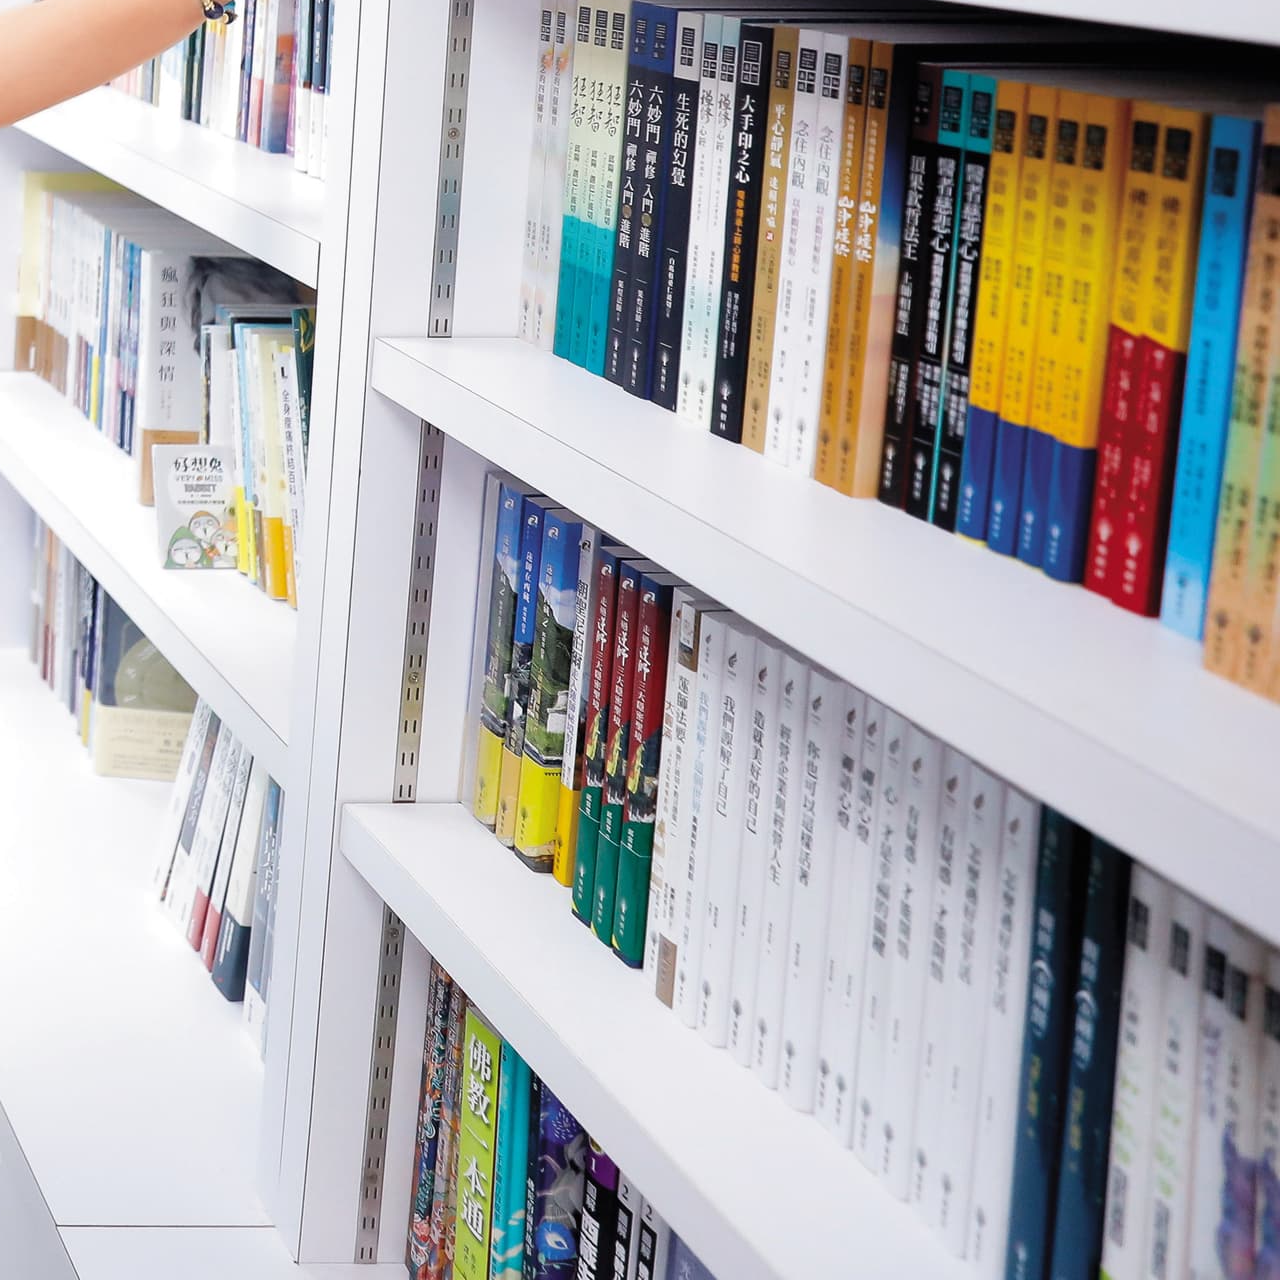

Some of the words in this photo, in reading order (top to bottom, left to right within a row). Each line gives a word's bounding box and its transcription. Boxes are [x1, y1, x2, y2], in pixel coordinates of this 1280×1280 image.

[570, 76, 587, 128] 狂智
[586, 79, 604, 132] 狂智
[603, 83, 621, 137] 狂智
[626, 80, 644, 138] 六妙門
[646, 86, 664, 144] 六妙門
[624, 142, 637, 172] 禪修
[643, 148, 657, 179] 禪修
[670, 93, 691, 187] 生死的幻覺
[734, 95, 757, 184] 大手印之心
[769, 104, 786, 168] 平心靜氣
[791, 119, 810, 190] 念住內觀
[815, 125, 835, 197] 念住內觀
[159, 265, 179, 383] 瘋狂與深情
[173, 456, 223, 473] 好想兔
[714, 695, 736, 817] 我們誤解了自己
[746, 708, 765, 834] 造就美好的自己
[460, 1032, 492, 1244] 佛教一本通
